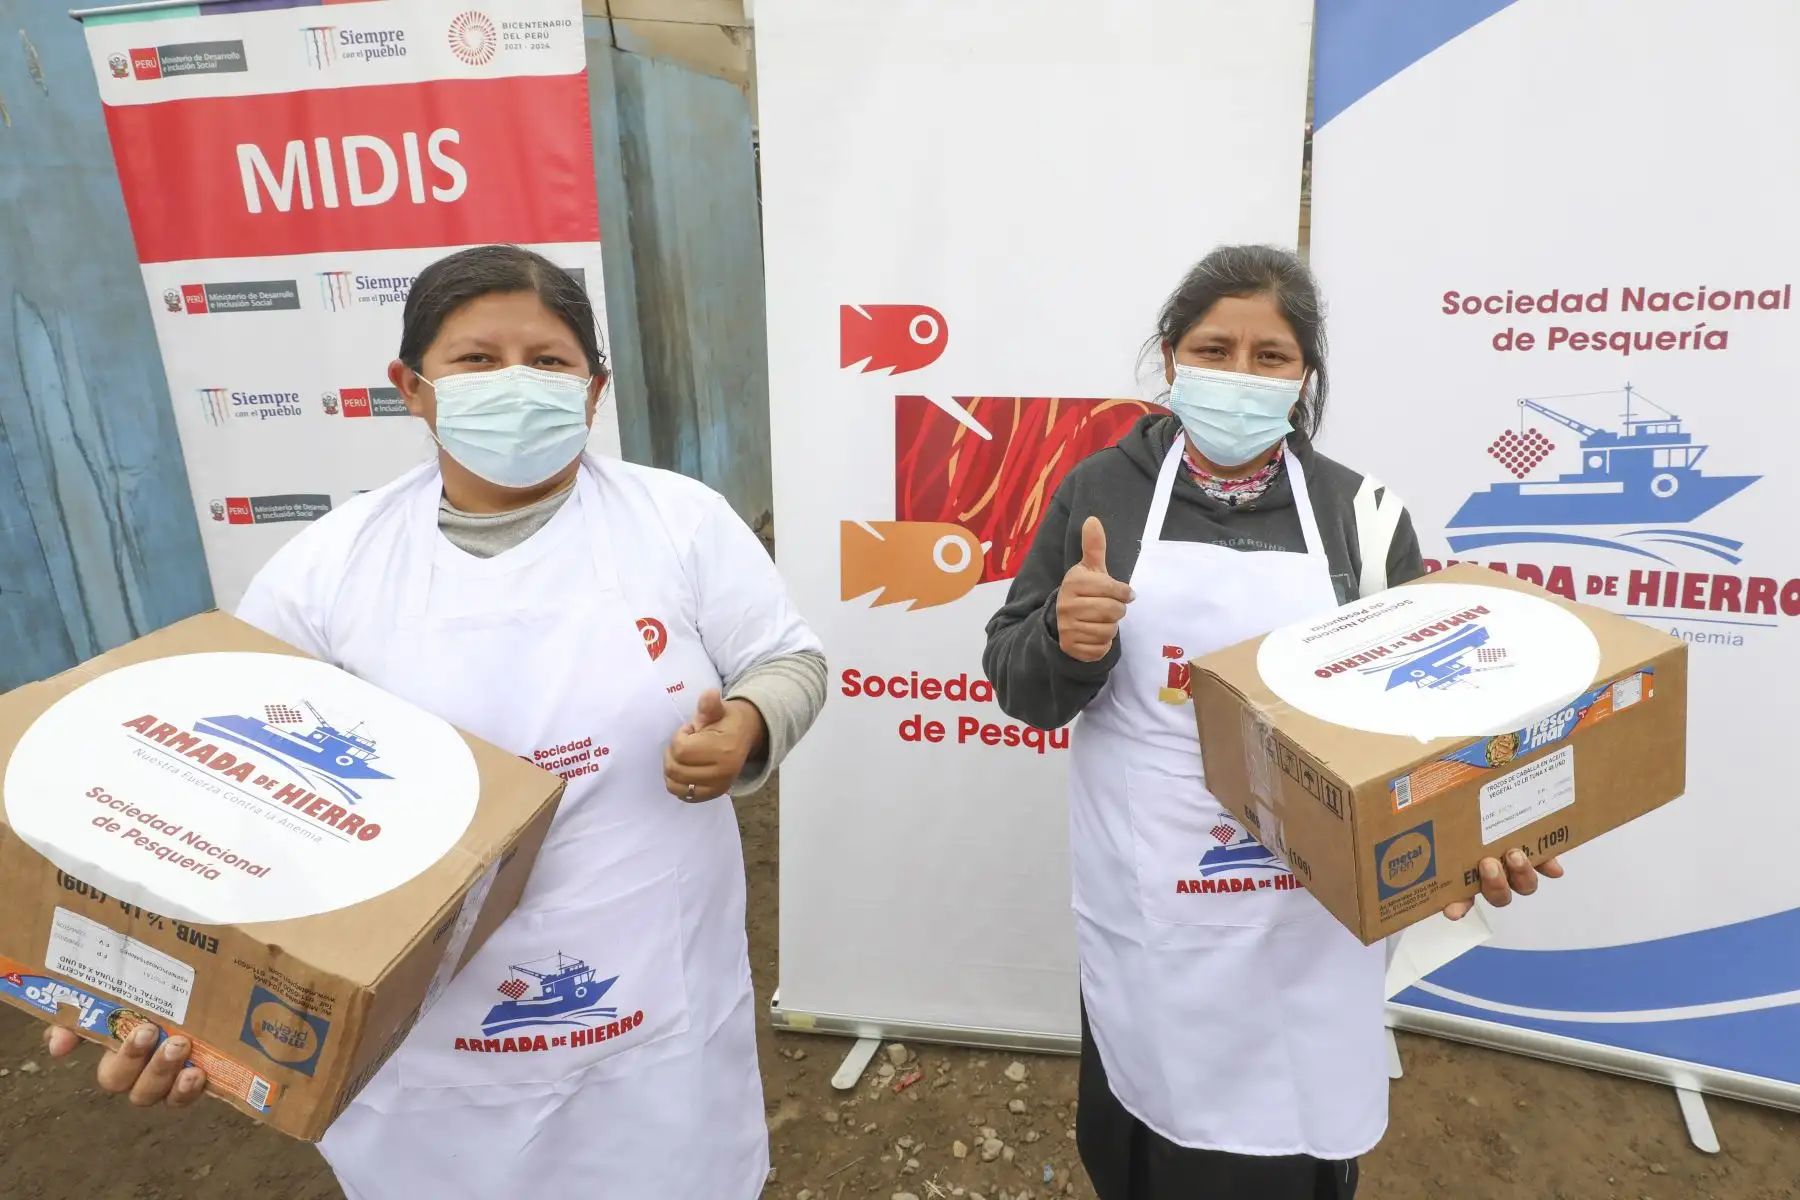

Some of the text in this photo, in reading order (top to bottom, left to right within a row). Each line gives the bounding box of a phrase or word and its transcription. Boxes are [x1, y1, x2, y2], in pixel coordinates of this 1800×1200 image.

[502, 20, 572, 30] BICENTENARIO
[340, 28, 404, 46] Siempre
[503, 30, 550, 40] DEL PERÚ
[356, 50, 364, 58] el
[365, 46, 406, 62] pueblo
[530, 42, 550, 50] 2024
[135, 58, 156, 68] PERÚ
[162, 55, 192, 64] Ministerio
[204, 52, 240, 60] Desarrollo
[168, 63, 195, 72] Inclusión
[197, 61, 217, 69] Social
[236, 127, 468, 214] MIDIS
[186, 295, 203, 304] PERÚ
[208, 292, 246, 300] Ministerio
[248, 292, 256, 300] de
[216, 300, 249, 308] Inclusión
[251, 299, 273, 307] Social
[372, 294, 378, 302] el
[380, 292, 409, 306] pueb
[1442, 284, 1791, 315] Sociedad Nacional
[1492, 322, 1728, 356] de Pesquería
[232, 392, 300, 409] Siempre
[344, 397, 366, 408] PERÚ
[250, 409, 258, 417] el
[260, 406, 302, 420] pueblo
[229, 506, 248, 516] PERÚ
[254, 505, 292, 513] Ministerio
[262, 511, 295, 519] Inclusión
[1586, 575, 1618, 596] DE
[1627, 570, 1800, 616] HIERRO
[1402, 604, 1491, 645] ARMADA
[1389, 640, 1404, 650] DE
[1669, 627, 1744, 646] Anemia
[1313, 644, 1392, 680] HIERRO
[841, 668, 993, 702] Socieda
[898, 714, 1070, 754] de Pesqu
[1531, 723, 1563, 748] mar
[534, 736, 592, 760] Sociedad
[594, 746, 610, 758] de
[121, 714, 381, 842] ARMADA DE HIERRO
[1487, 778, 1507, 792] TROZOS
[1508, 774, 1514, 782] DE
[1517, 763, 1539, 778] CABALLA
[1549, 751, 1566, 763] ACEITE
[133, 748, 180, 774] Nuestra
[182, 770, 222, 794] Fuerza
[264, 810, 280, 820] la
[280, 816, 323, 844] Anemia
[1488, 783, 1512, 798] VEGETAL
[86, 786, 272, 879] Sociedad Nacional
[1538, 826, 1569, 854] (109)
[92, 814, 222, 880] de Pesquería
[1388, 845, 1421, 869] metal
[1389, 859, 1413, 880] pren
[1176, 878, 1256, 894] ARMADA
[1259, 880, 1271, 888] DE
[171, 919, 219, 953] EMB.
[58, 955, 77, 966] UND
[76, 962, 87, 970] 48
[93, 969, 115, 982] TUNA
[115, 978, 127, 988] LB
[55, 962, 174, 1017] TROZOS DE CABALLA EN ACEITE
[139, 989, 173, 1008] VEGETAL
[260, 1019, 304, 1049] metal
[454, 1010, 644, 1052] ARMADA DE HIERRO
